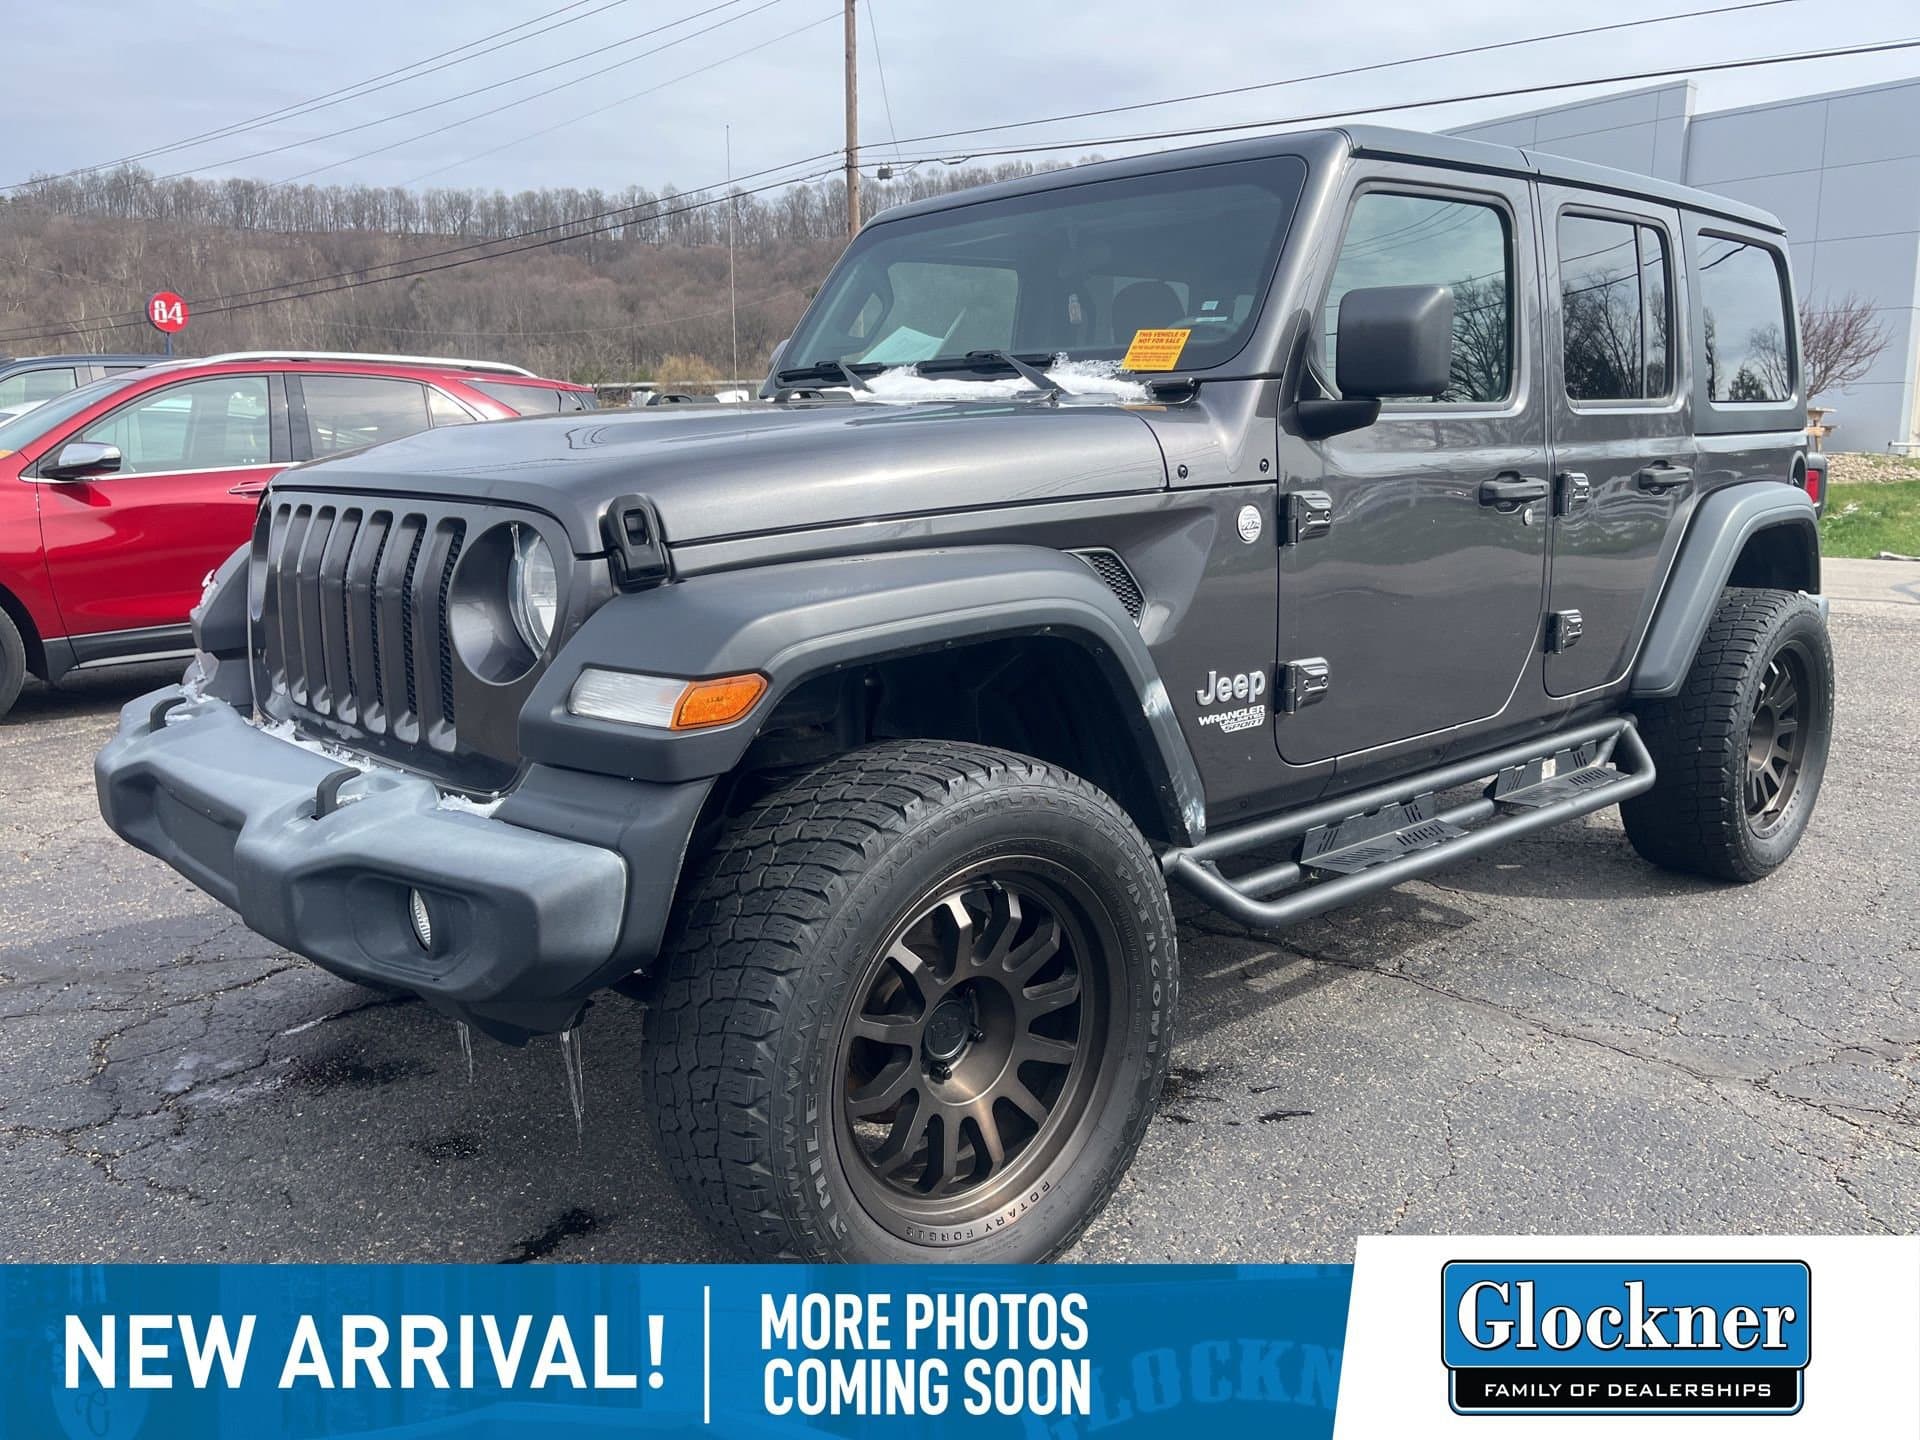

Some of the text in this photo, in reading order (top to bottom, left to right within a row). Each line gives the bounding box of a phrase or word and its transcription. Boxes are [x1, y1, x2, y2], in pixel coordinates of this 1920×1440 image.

[154, 300, 184, 325] 84
[1196, 670, 1266, 706] Jeep
[1198, 705, 1265, 726] WRANGLER
